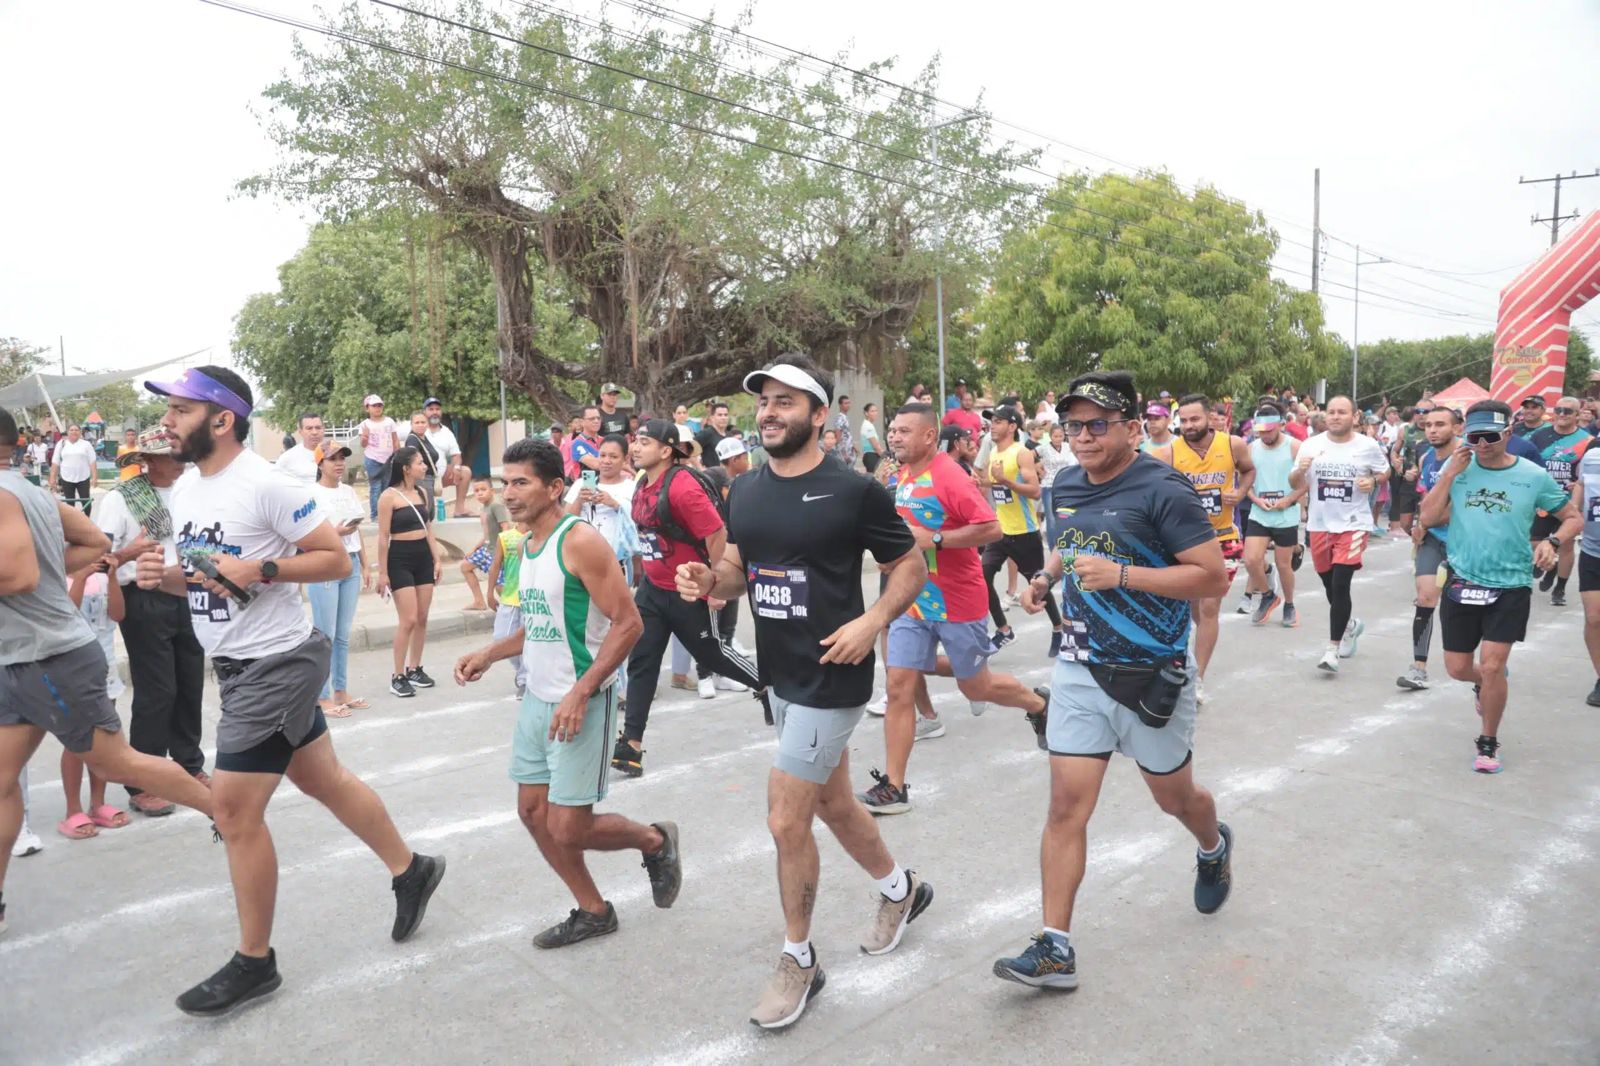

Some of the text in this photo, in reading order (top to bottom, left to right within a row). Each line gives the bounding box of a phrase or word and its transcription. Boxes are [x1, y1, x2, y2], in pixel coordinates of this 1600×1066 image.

[1545, 460, 1571, 472] OWER
[1323, 487, 1346, 498] 0463
[754, 582, 792, 606] 0438
[1461, 588, 1490, 599] 0451
[187, 591, 209, 611] 427
[790, 604, 808, 617] 10k
